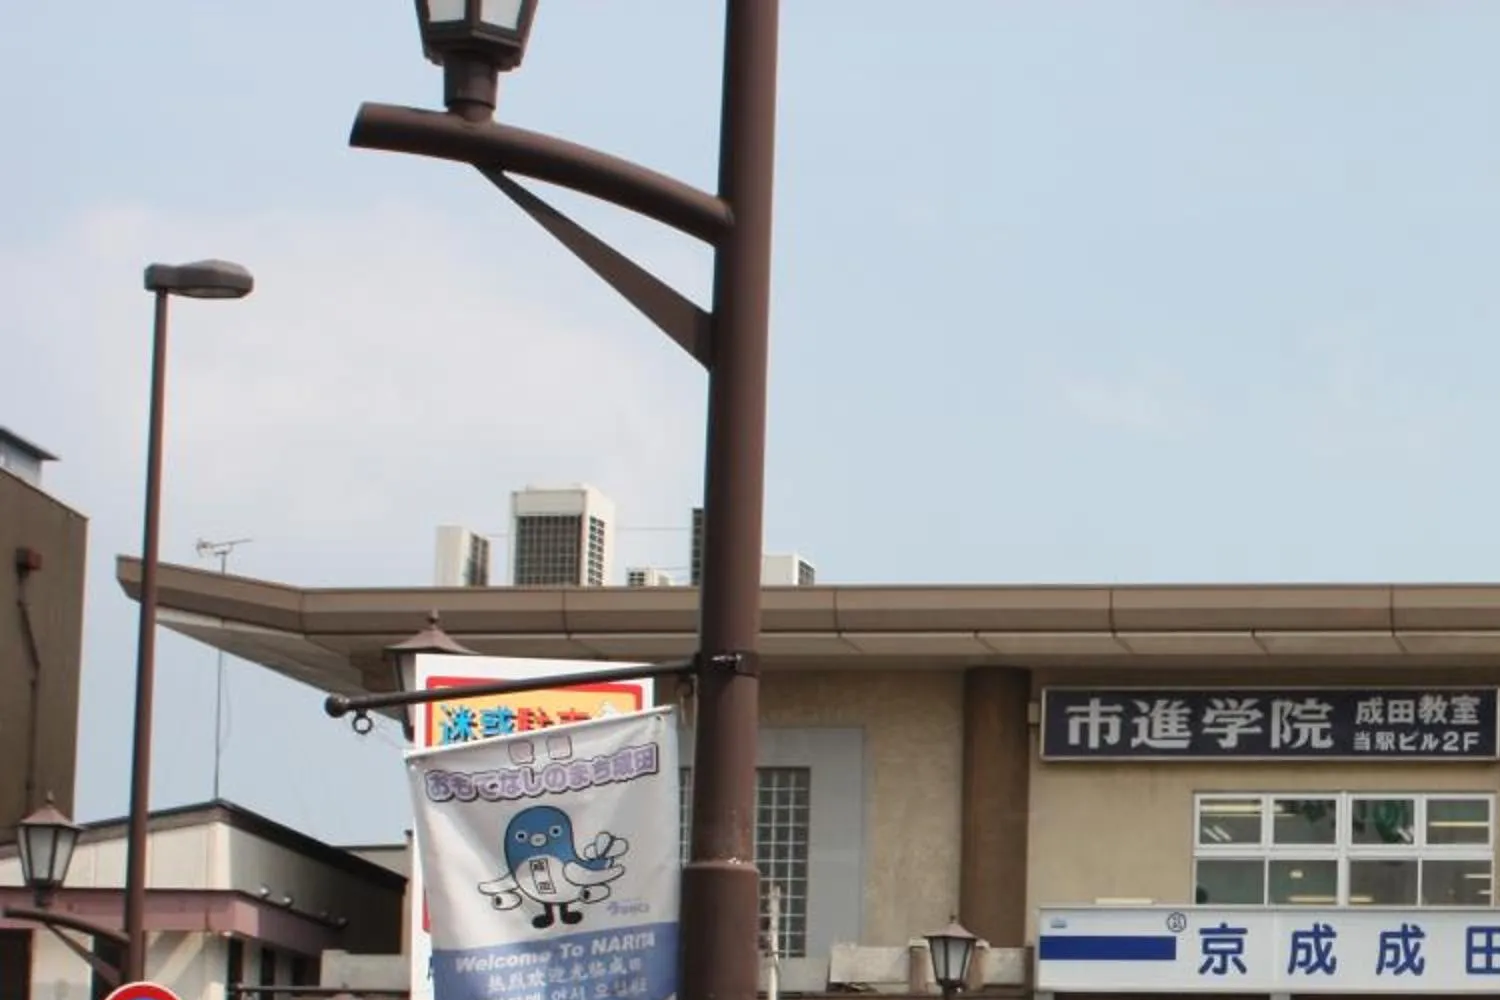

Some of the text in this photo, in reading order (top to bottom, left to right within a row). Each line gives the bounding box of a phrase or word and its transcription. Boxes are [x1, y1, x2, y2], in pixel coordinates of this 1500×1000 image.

[1065, 698, 1334, 749] 市進学院
[1356, 694, 1480, 725] 成田教室
[1353, 730, 1480, 752] 当駅ビル2F
[456, 932, 655, 974] Welcome To NARITA
